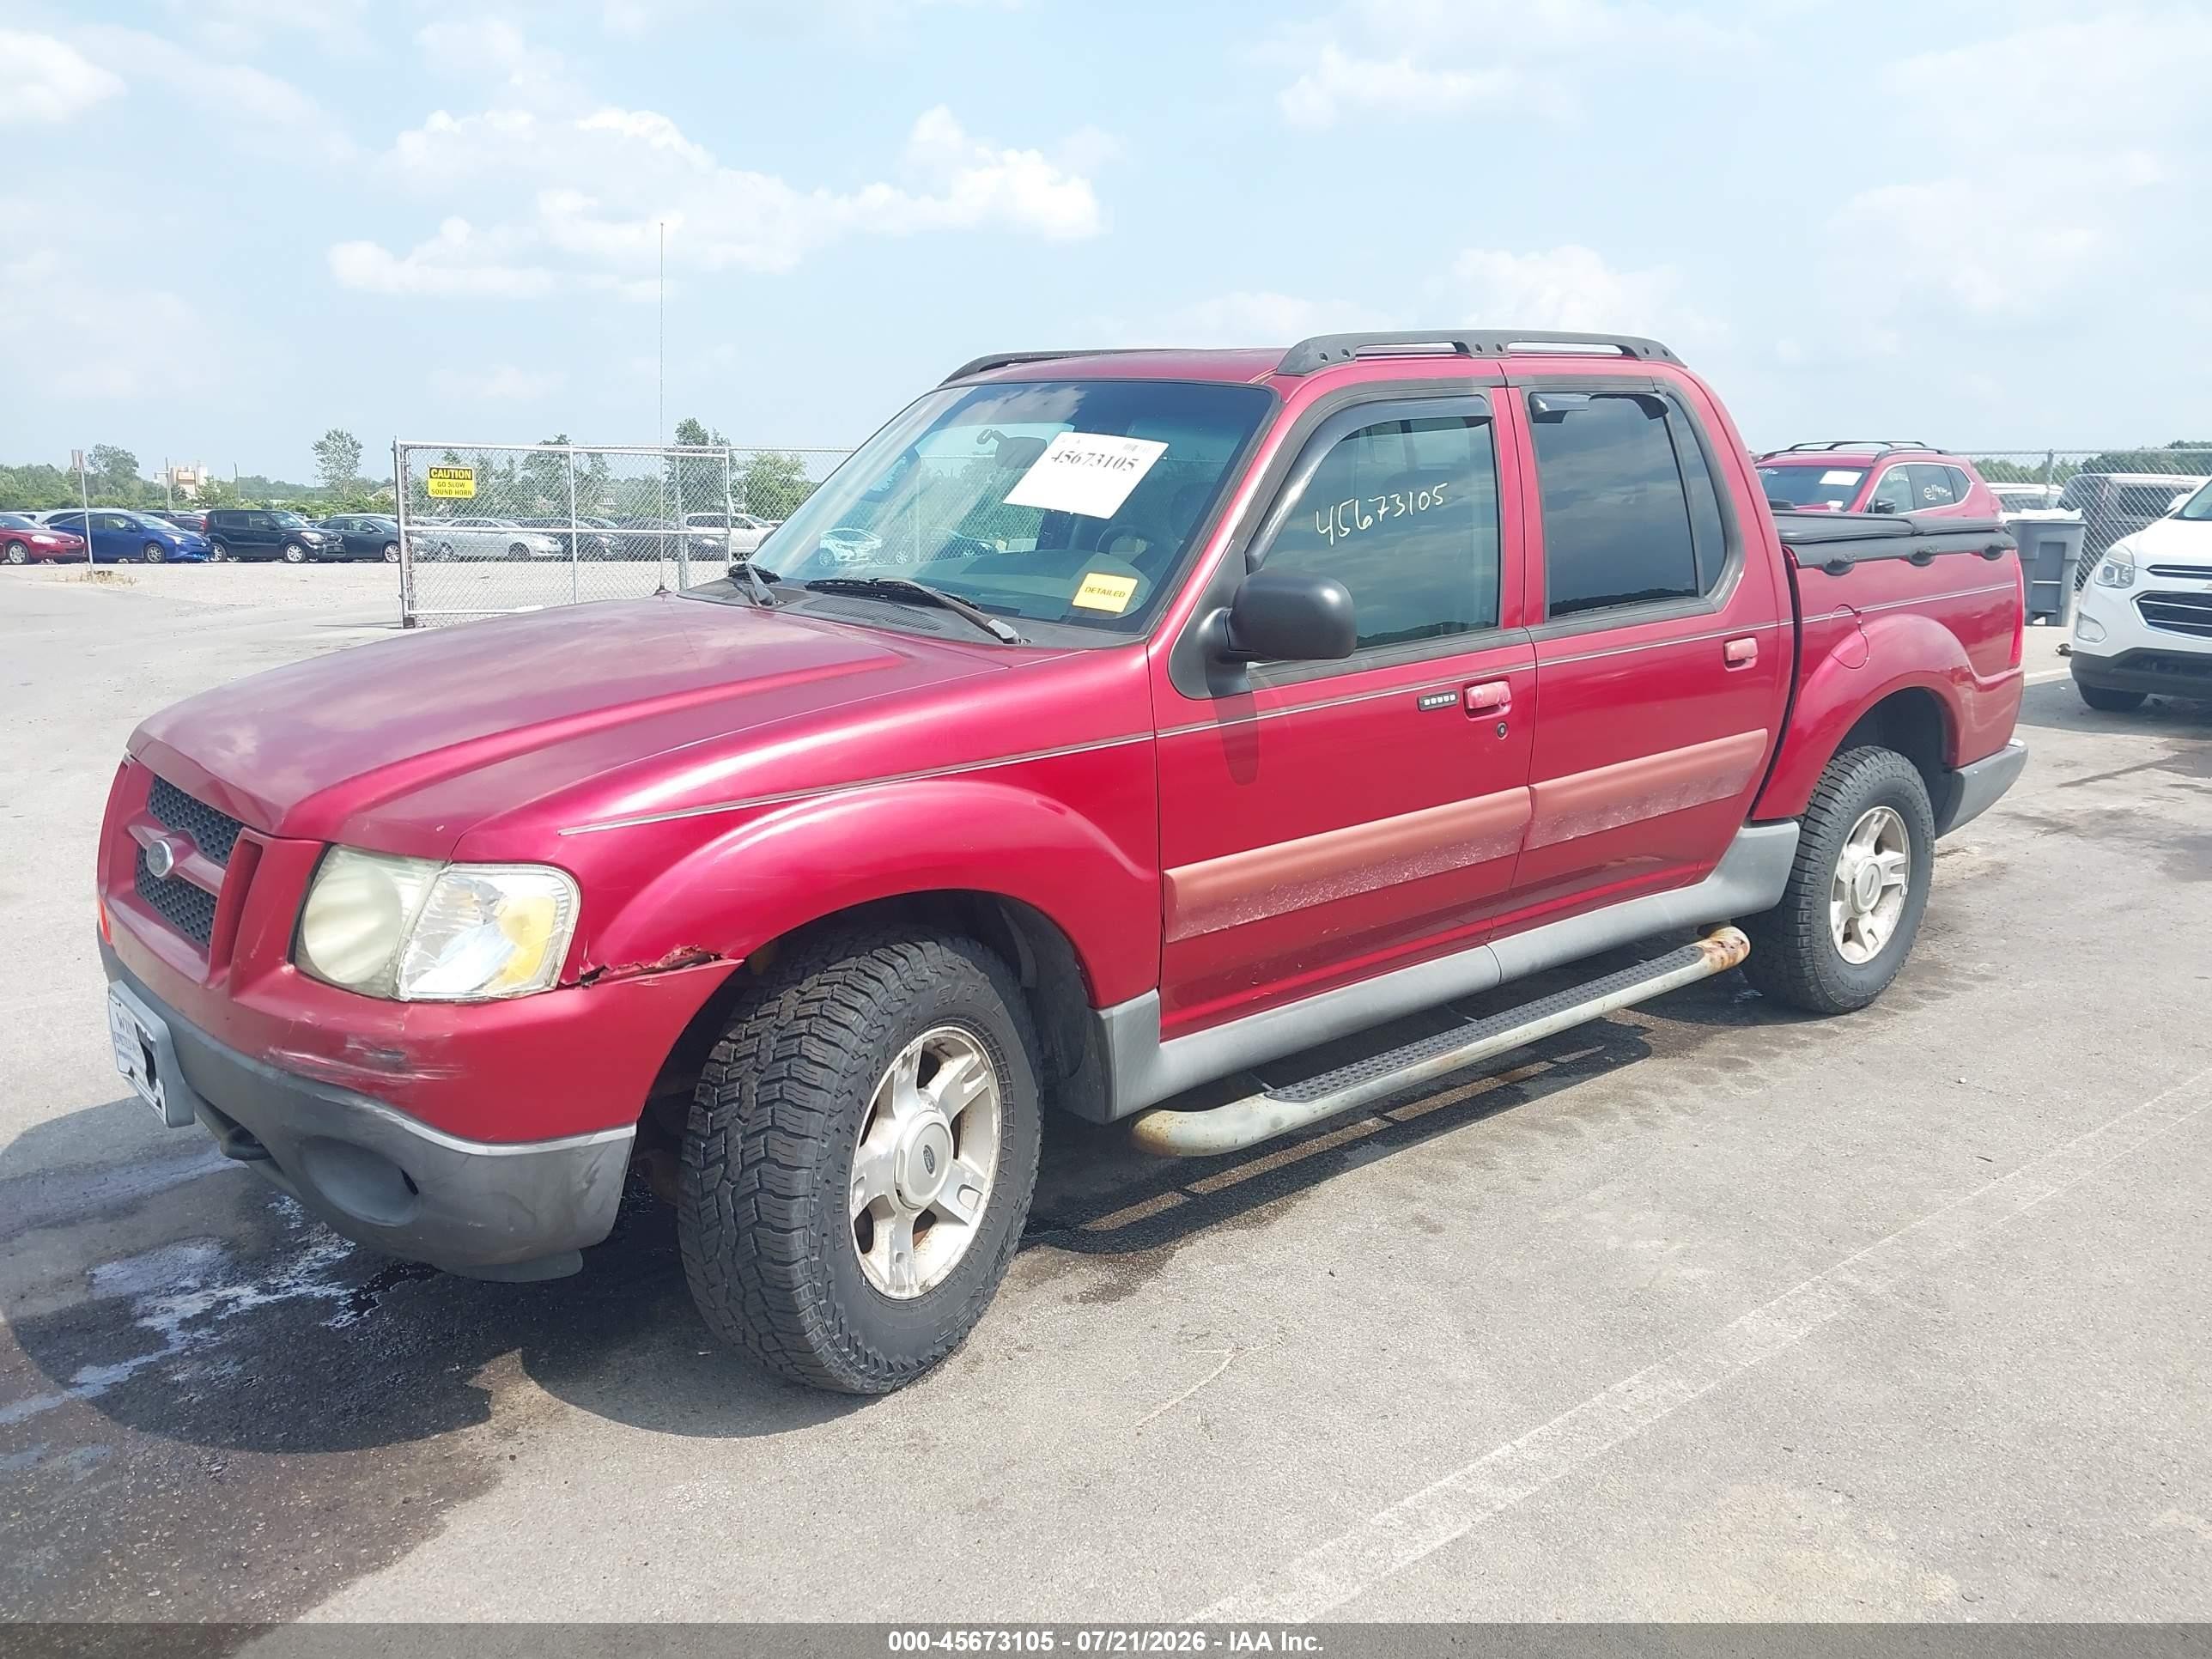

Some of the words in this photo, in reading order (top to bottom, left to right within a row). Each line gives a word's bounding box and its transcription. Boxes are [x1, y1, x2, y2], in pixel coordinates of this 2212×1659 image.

[1050, 449, 1139, 471] 45673105
[430, 468, 471, 479] CAUTION
[1316, 482, 1449, 546] 45673105
[1085, 586, 1126, 598] DETAILED
